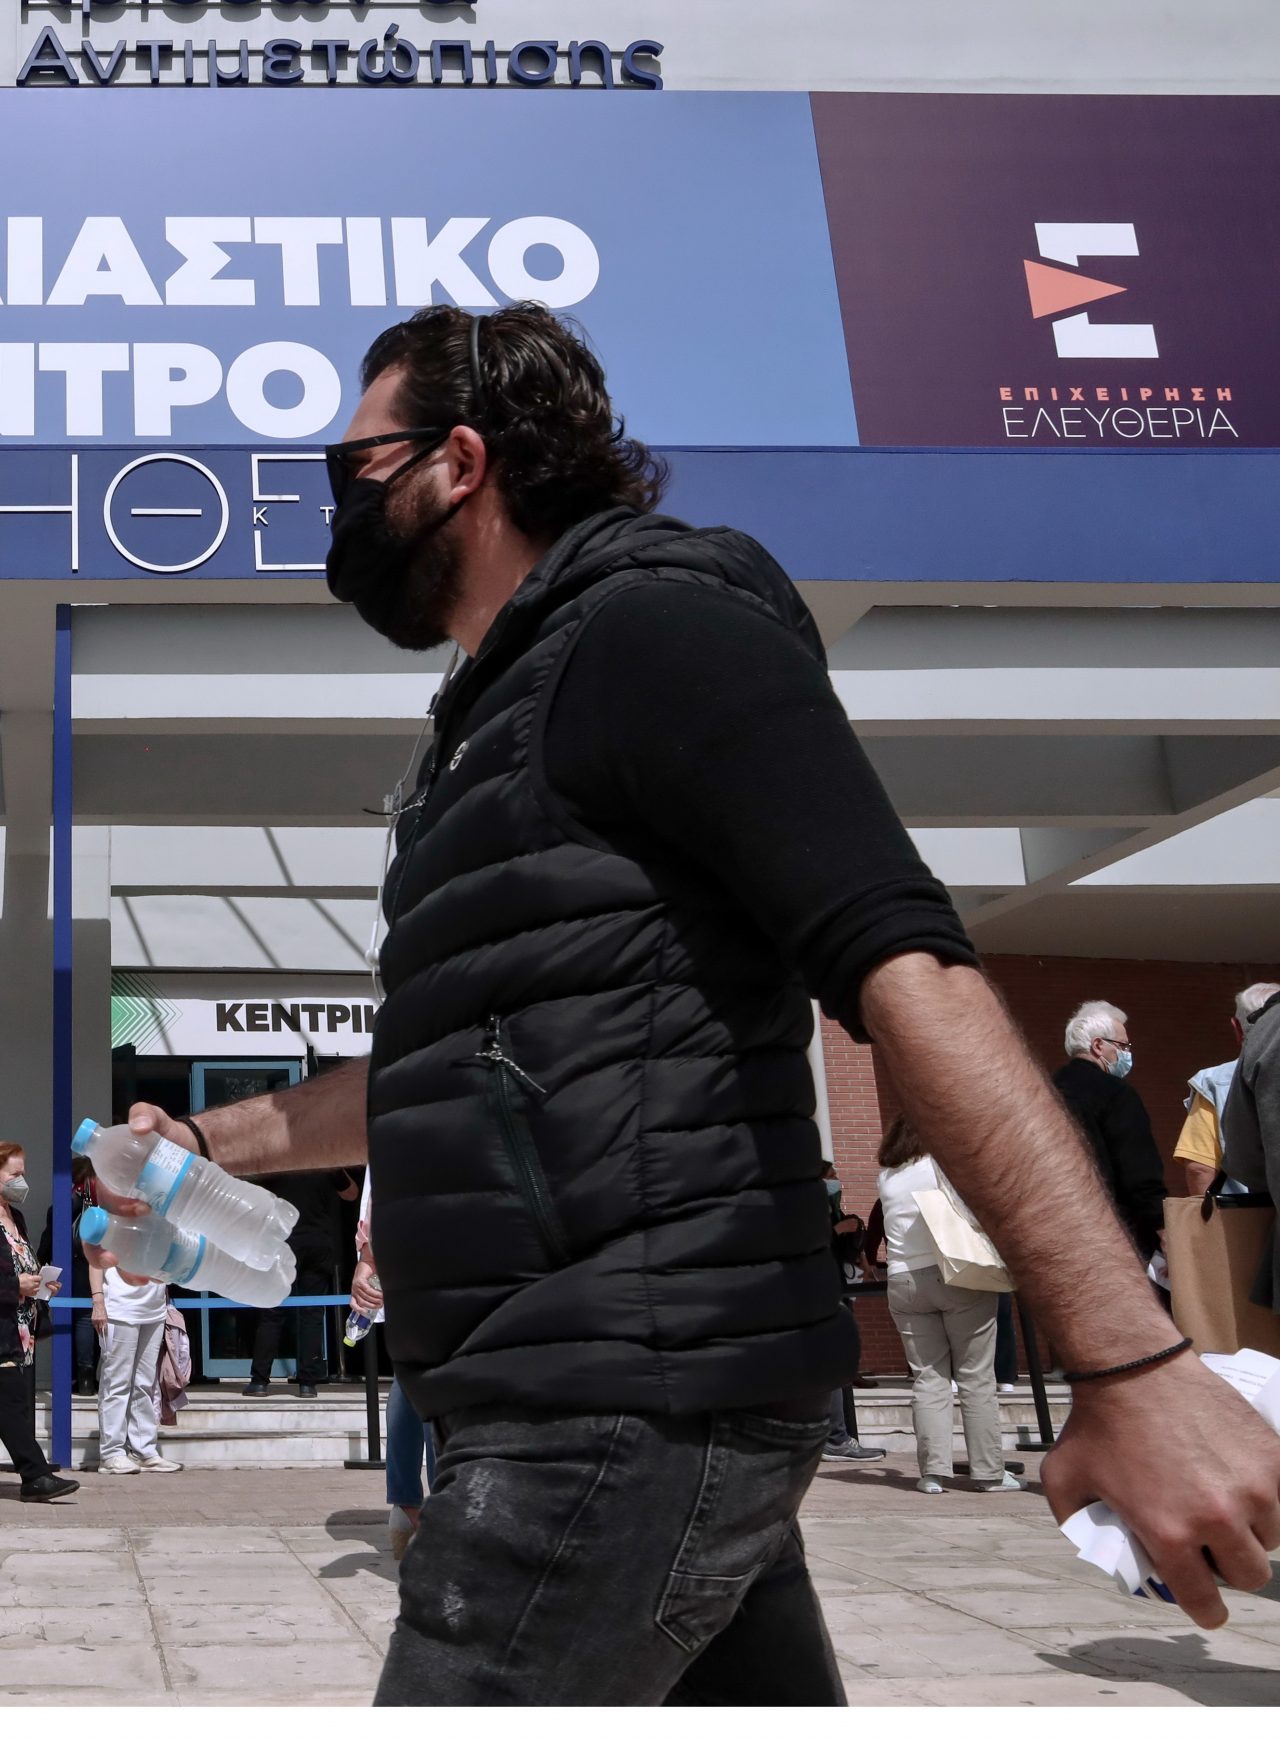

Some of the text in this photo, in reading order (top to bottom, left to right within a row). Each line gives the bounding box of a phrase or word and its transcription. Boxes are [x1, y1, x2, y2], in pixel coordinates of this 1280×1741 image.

[16, 24, 664, 90] Αντιμετώπισης
[999, 387, 1233, 401] ΕΠΙΧΕΙΡΗΣΗ
[1002, 407, 1239, 438] ΕΛΕΥΘΕΡΙΑ
[216, 1003, 381, 1033] ΚΕΝΤΡΙ
